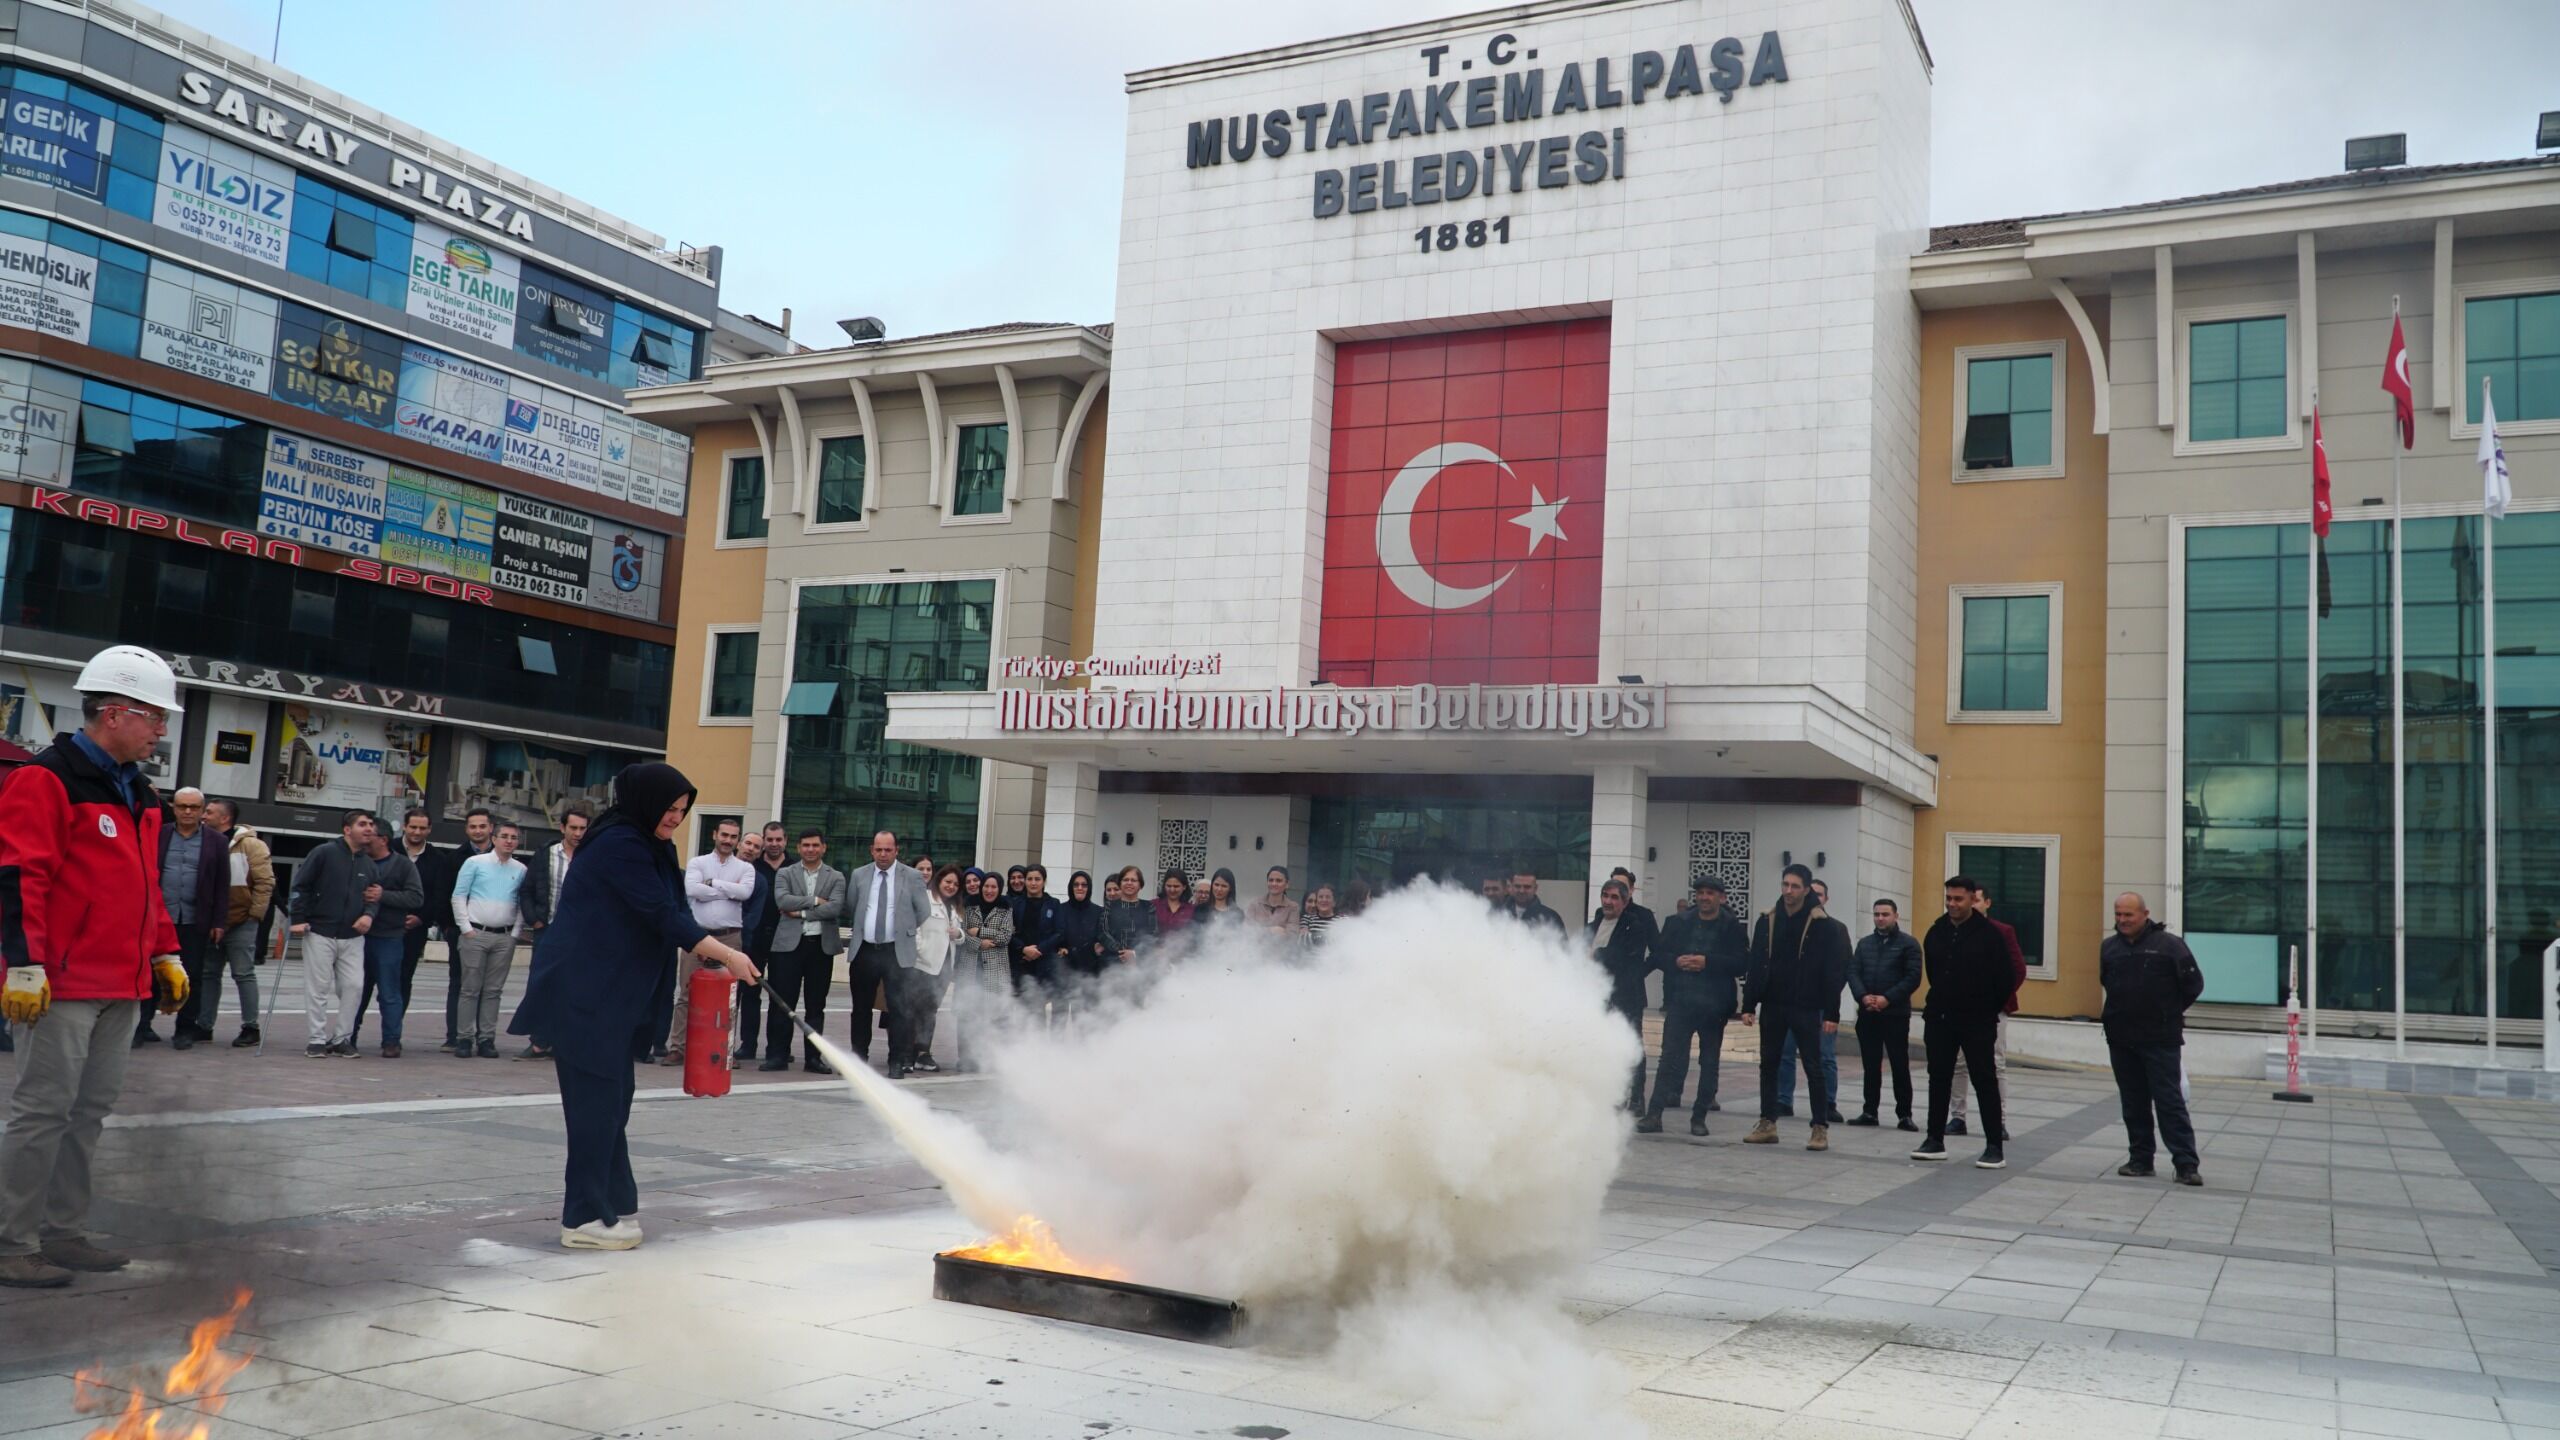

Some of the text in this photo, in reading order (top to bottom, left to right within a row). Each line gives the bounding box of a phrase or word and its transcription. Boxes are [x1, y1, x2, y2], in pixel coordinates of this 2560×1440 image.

[1421, 33, 1538, 78] T.C.
[1186, 30, 1790, 169] MUSTAFAKEMALPAŞA
[14, 101, 90, 142] GEDİK
[180, 71, 535, 242] SARAY PLAZA
[1313, 126, 1625, 219] BELEDİYESİ
[169, 150, 286, 220] YILDIZ
[182, 206, 281, 252] 0537 914 78 73
[1415, 215, 1510, 254] 1881
[411, 281, 431, 298] Zirai
[412, 255, 515, 312] EGE TARIM
[32, 308, 80, 328] YAPILARIN
[426, 301, 456, 318] Kemal
[430, 312, 450, 326] 0532
[452, 320, 468, 332] 246
[482, 331, 493, 340] 44
[148, 323, 218, 353] PARLAKLAR
[223, 345, 265, 368] HARİTA
[166, 343, 194, 361] Ömer
[196, 353, 256, 380] PARLAKLAR
[412, 351, 446, 368] MELAS
[447, 363, 458, 373] ve
[167, 355, 251, 388] 0534 557 19 41
[281, 339, 395, 394] SOYKAR
[287, 367, 388, 416] İNŞAAT
[415, 412, 503, 450] KARAN
[542, 411, 601, 443] DIALOG
[310, 447, 365, 472] SERBEST
[502, 452, 566, 479] GAYRİMENKUL
[505, 433, 552, 464] İMZA
[555, 452, 566, 468] 2
[265, 470, 381, 515] MALİ MÜŞAVİR
[263, 498, 375, 540] PERVİN KÖSE
[550, 508, 589, 531] MİMAR
[32, 486, 303, 567] KAPLAN
[335, 558, 494, 607] SPOR
[265, 521, 370, 555] 614 14 44
[389, 529, 446, 554] MUZAFFER
[499, 525, 541, 550] CANER
[544, 536, 588, 560] TAŞKIN
[495, 570, 526, 590] 0.532
[529, 578, 550, 595] 062
[553, 583, 567, 599] 53
[570, 587, 583, 602] 16
[503, 554, 578, 582] Proje & Tasarım
[167, 653, 325, 697] ARAY
[332, 683, 445, 716] AVM
[1000, 652, 1222, 681] Türkiye Cumhuriyeti
[995, 682, 1667, 738] Mustafakemalpaşa Belediyesi
